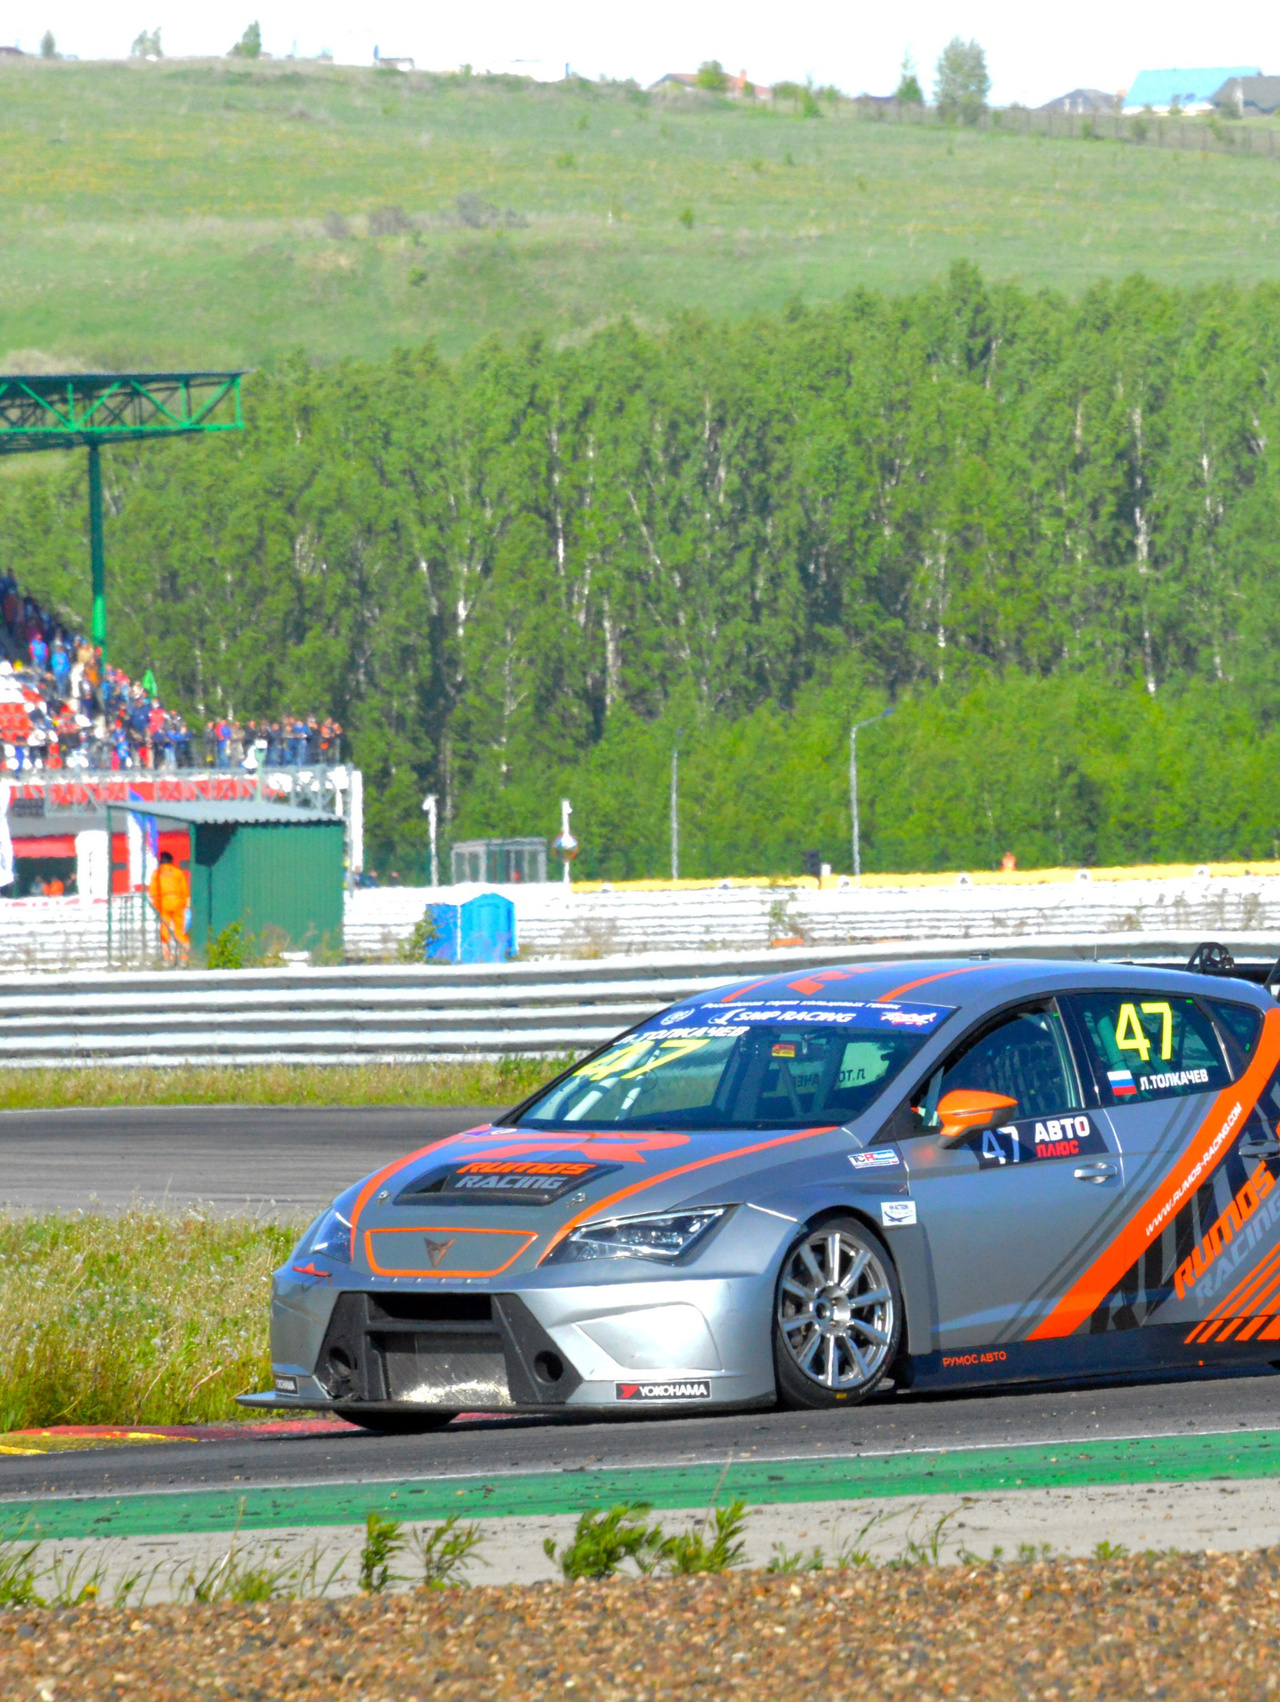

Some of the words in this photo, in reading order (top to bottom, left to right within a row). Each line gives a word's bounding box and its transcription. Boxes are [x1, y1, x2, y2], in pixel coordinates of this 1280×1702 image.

[733, 1010, 782, 1021] SMP
[777, 1011, 857, 1023] RACING
[1115, 1002, 1172, 1061] 47
[572, 1039, 710, 1081] 47
[1140, 1068, 1209, 1091] Л.ТОЛКАЧЕВ
[1034, 1116, 1090, 1143] АВТО
[982, 1125, 1020, 1164] 47
[1036, 1140, 1080, 1158] ПЛЮС
[455, 1161, 597, 1175] RUMOS
[849, 1153, 875, 1164] TCR
[1145, 1101, 1243, 1237] WWW.RUMOS-RACING.COM
[454, 1175, 568, 1190] RACING
[1173, 1160, 1276, 1301] RUMOS
[942, 1354, 978, 1368] РУМОС
[980, 1350, 1007, 1363] АВТО
[639, 1384, 708, 1397] YOKOHAMA
